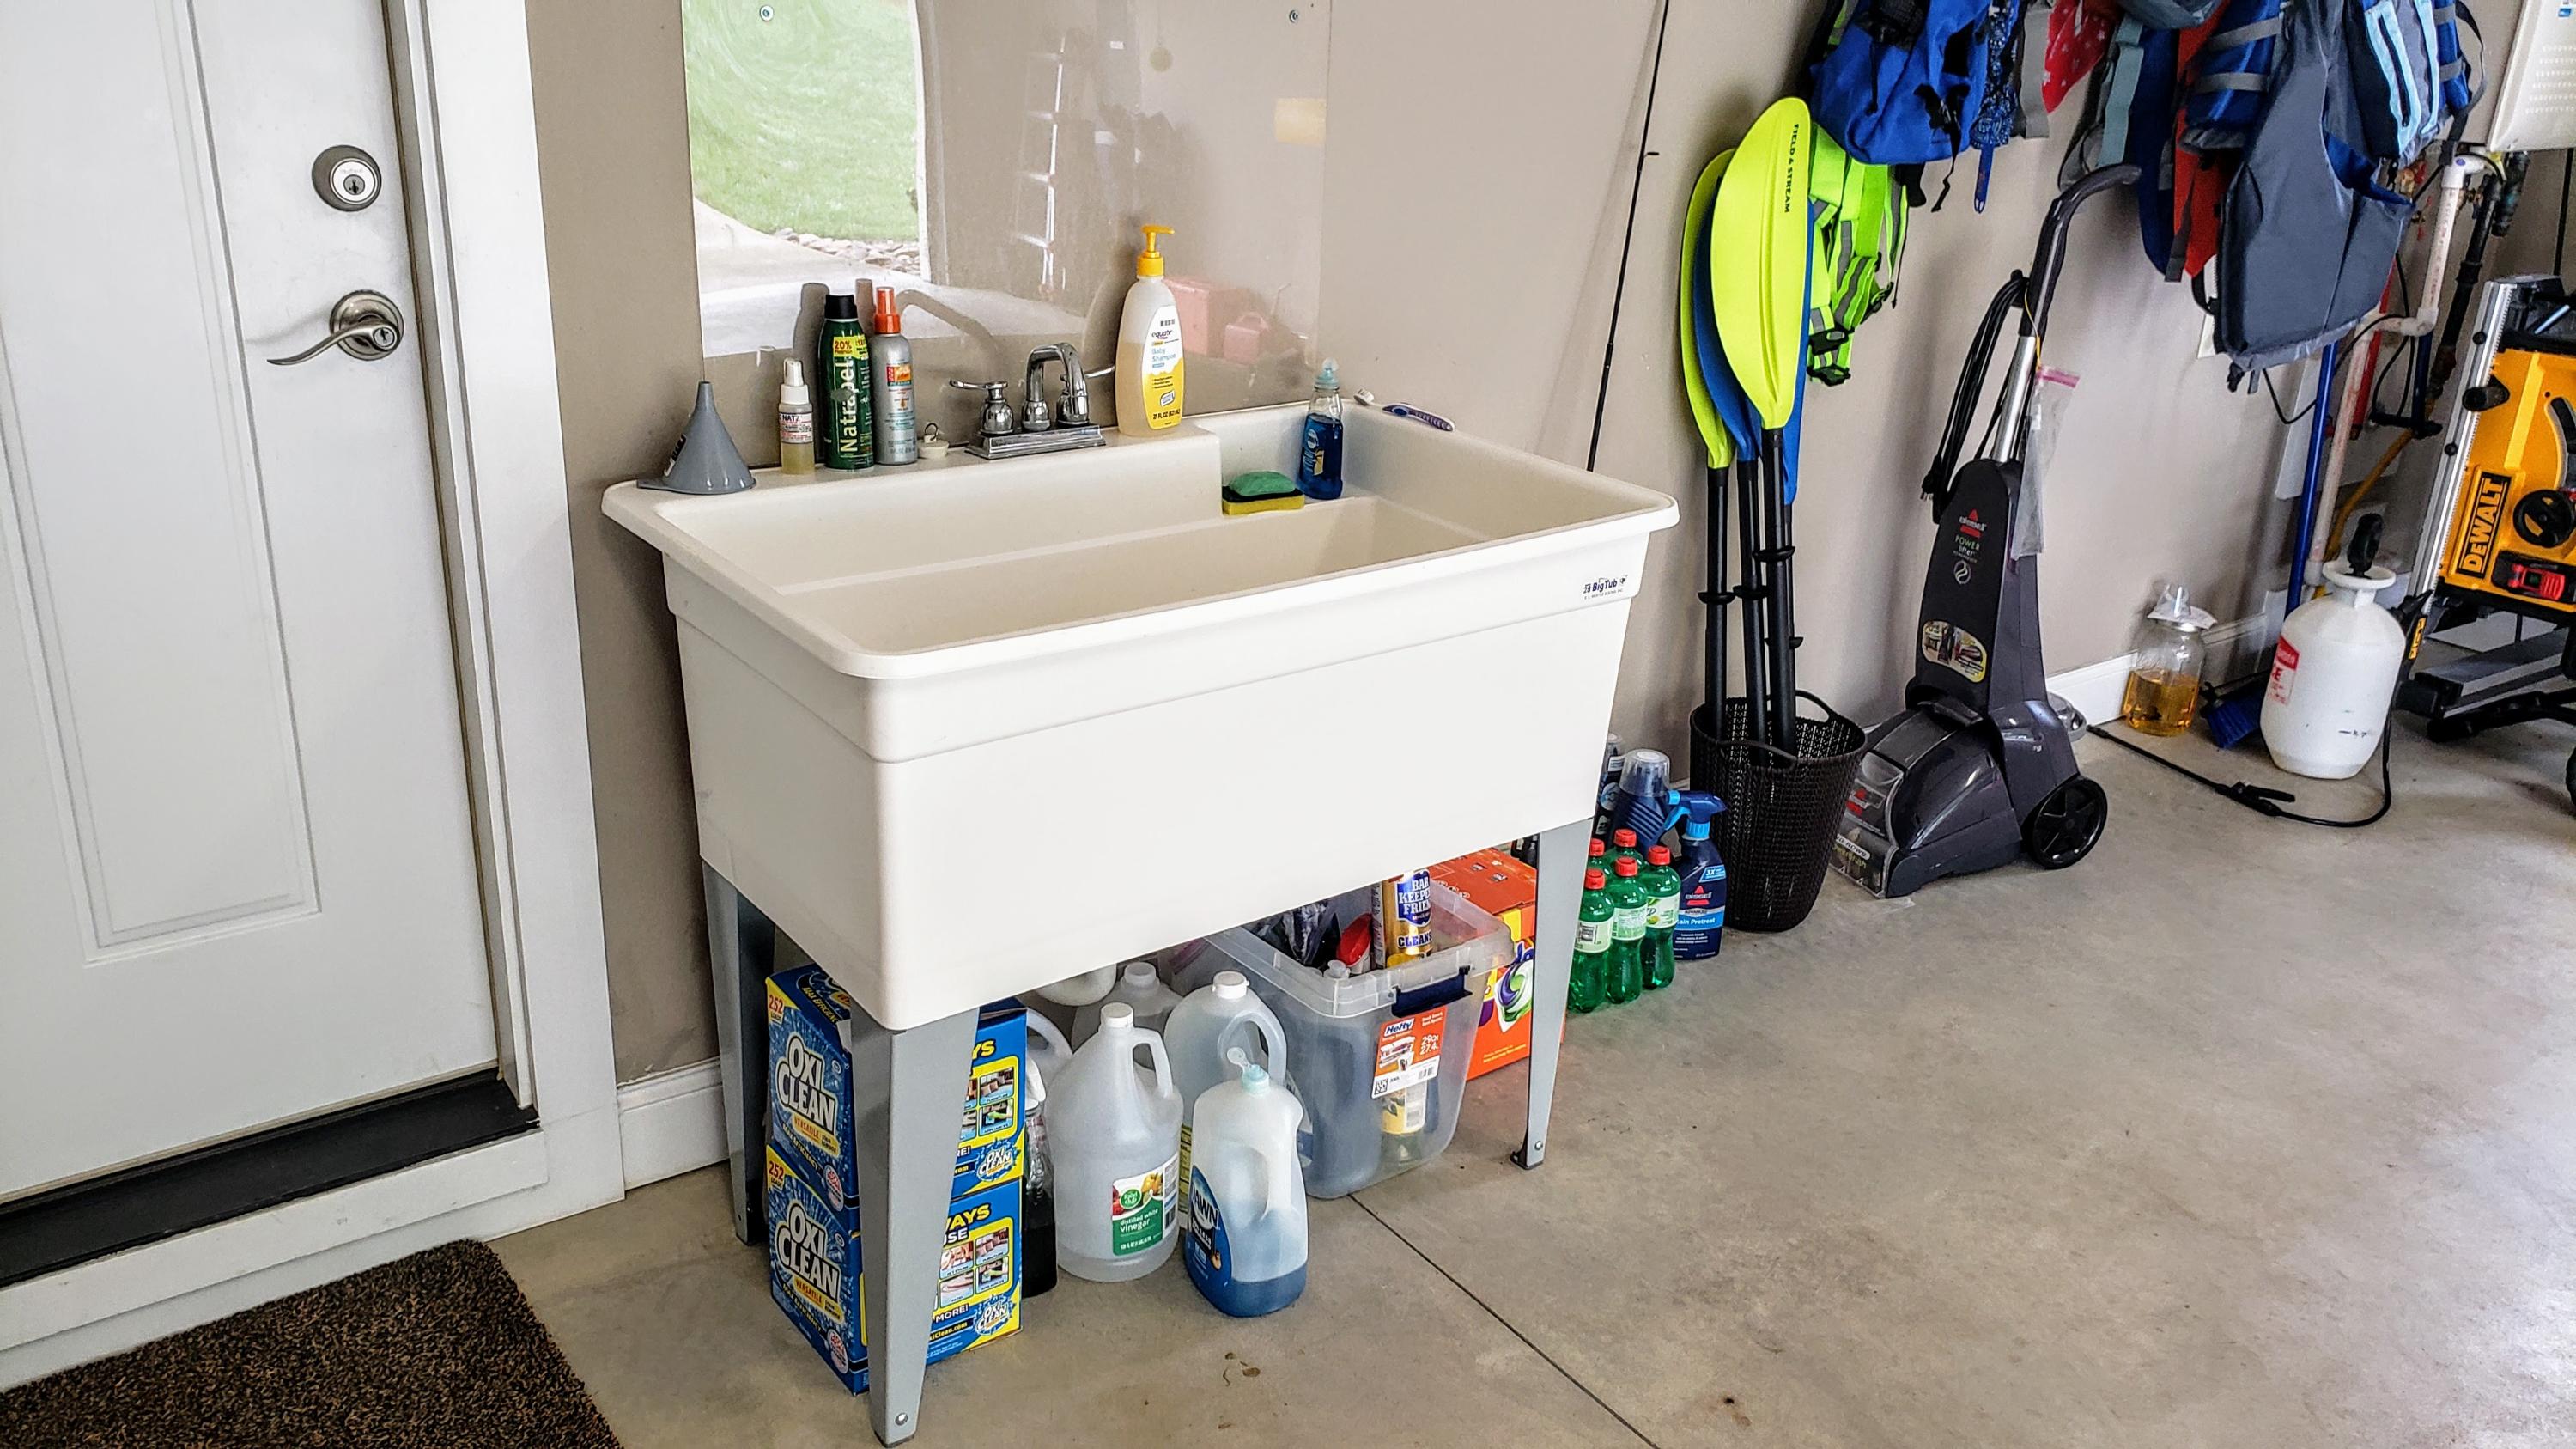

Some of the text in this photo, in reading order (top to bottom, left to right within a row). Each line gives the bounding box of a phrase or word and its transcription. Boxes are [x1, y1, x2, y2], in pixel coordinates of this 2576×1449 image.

[1789, 124, 1799, 155] FIELD
[1784, 167, 1793, 213] STREAM
[834, 340, 852, 350] 20%
[835, 358, 859, 453] Natrapel
[1954, 534, 1980, 551] POWER
[769, 994, 784, 1014] 252
[1385, 1020, 1413, 1035] Hefty
[787, 1034, 823, 1091] OXI
[777, 1059, 835, 1133] CLEAN
[979, 1152, 1012, 1175] CLEAN
[986, 1147, 1005, 1163] OXI
[769, 1160, 785, 1181] 252
[1120, 1209, 1159, 1227] distilled white
[1120, 1218, 1151, 1233] vinegar
[789, 1204, 825, 1260] OXI
[777, 1226, 839, 1300] CLEAN
[935, 1304, 969, 1324] MORE!
[977, 1305, 1007, 1331] CLEAN
[983, 1300, 1002, 1318] OXI
